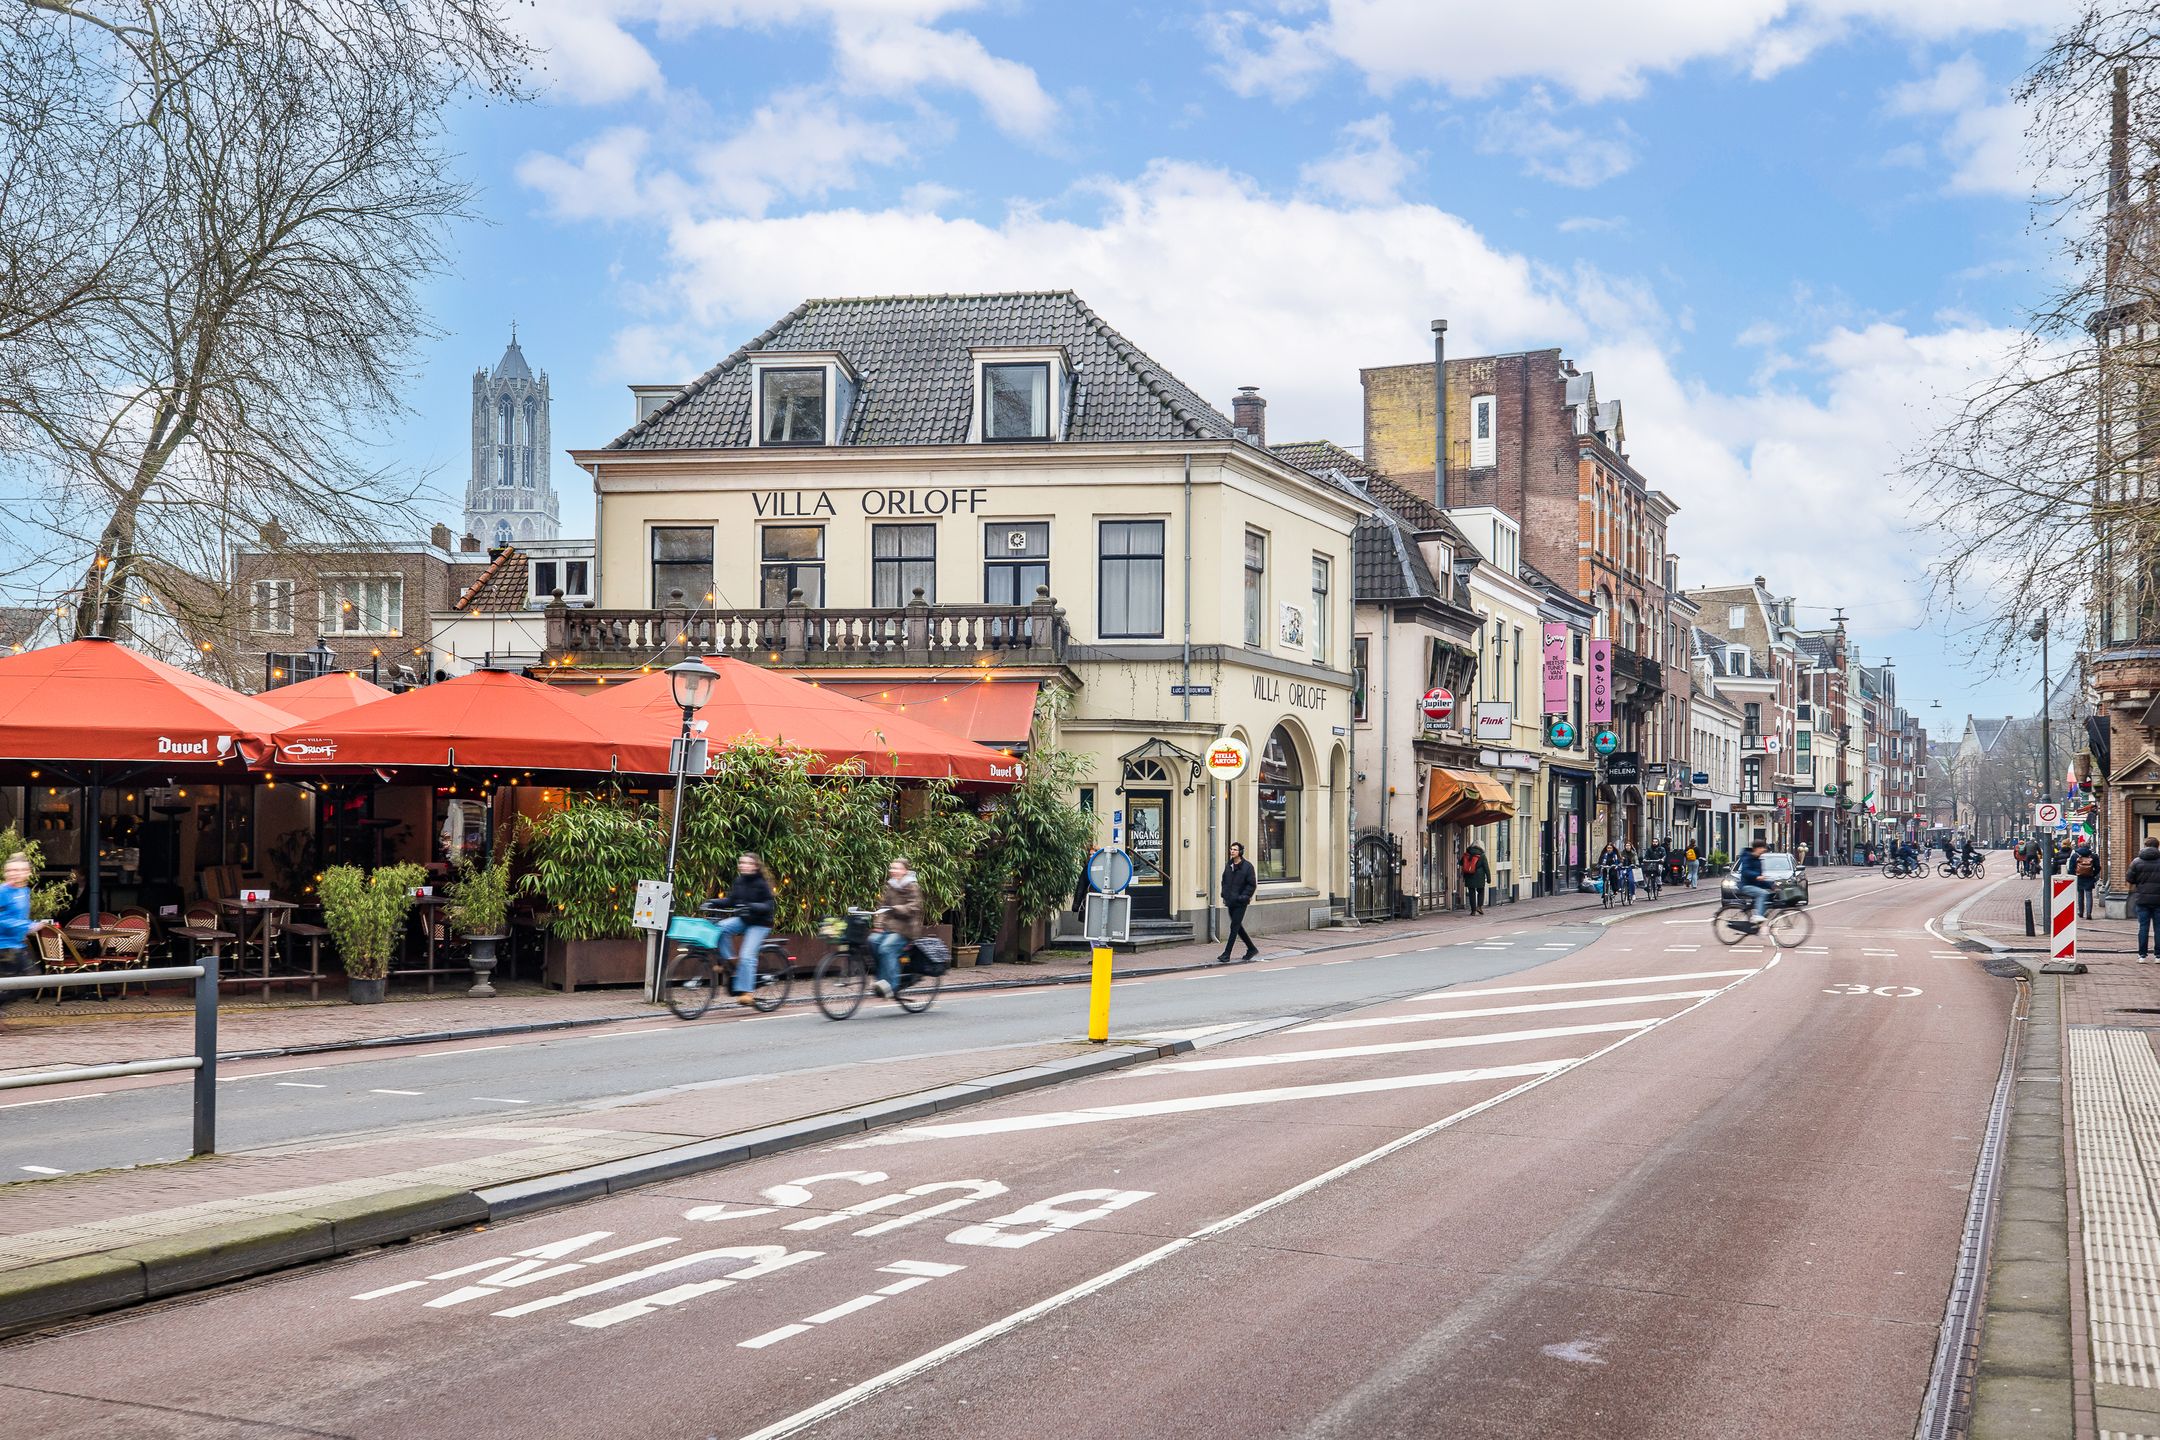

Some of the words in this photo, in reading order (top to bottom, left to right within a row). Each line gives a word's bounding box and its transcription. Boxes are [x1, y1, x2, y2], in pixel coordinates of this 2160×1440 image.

[752, 491, 837, 516] VILLA
[861, 488, 987, 515] ORLOFF
[1252, 674, 1281, 704] VILLA
[1288, 682, 1327, 711] ORLOFF
[1424, 700, 1452, 708] Jupiler
[1480, 717, 1504, 725] Flink
[158, 736, 209, 754] Duvel
[990, 764, 1012, 777] Duvel
[1130, 831, 1159, 840] INGANG
[1821, 983, 1924, 998] 30
[685, 1170, 1156, 1249] BUS
